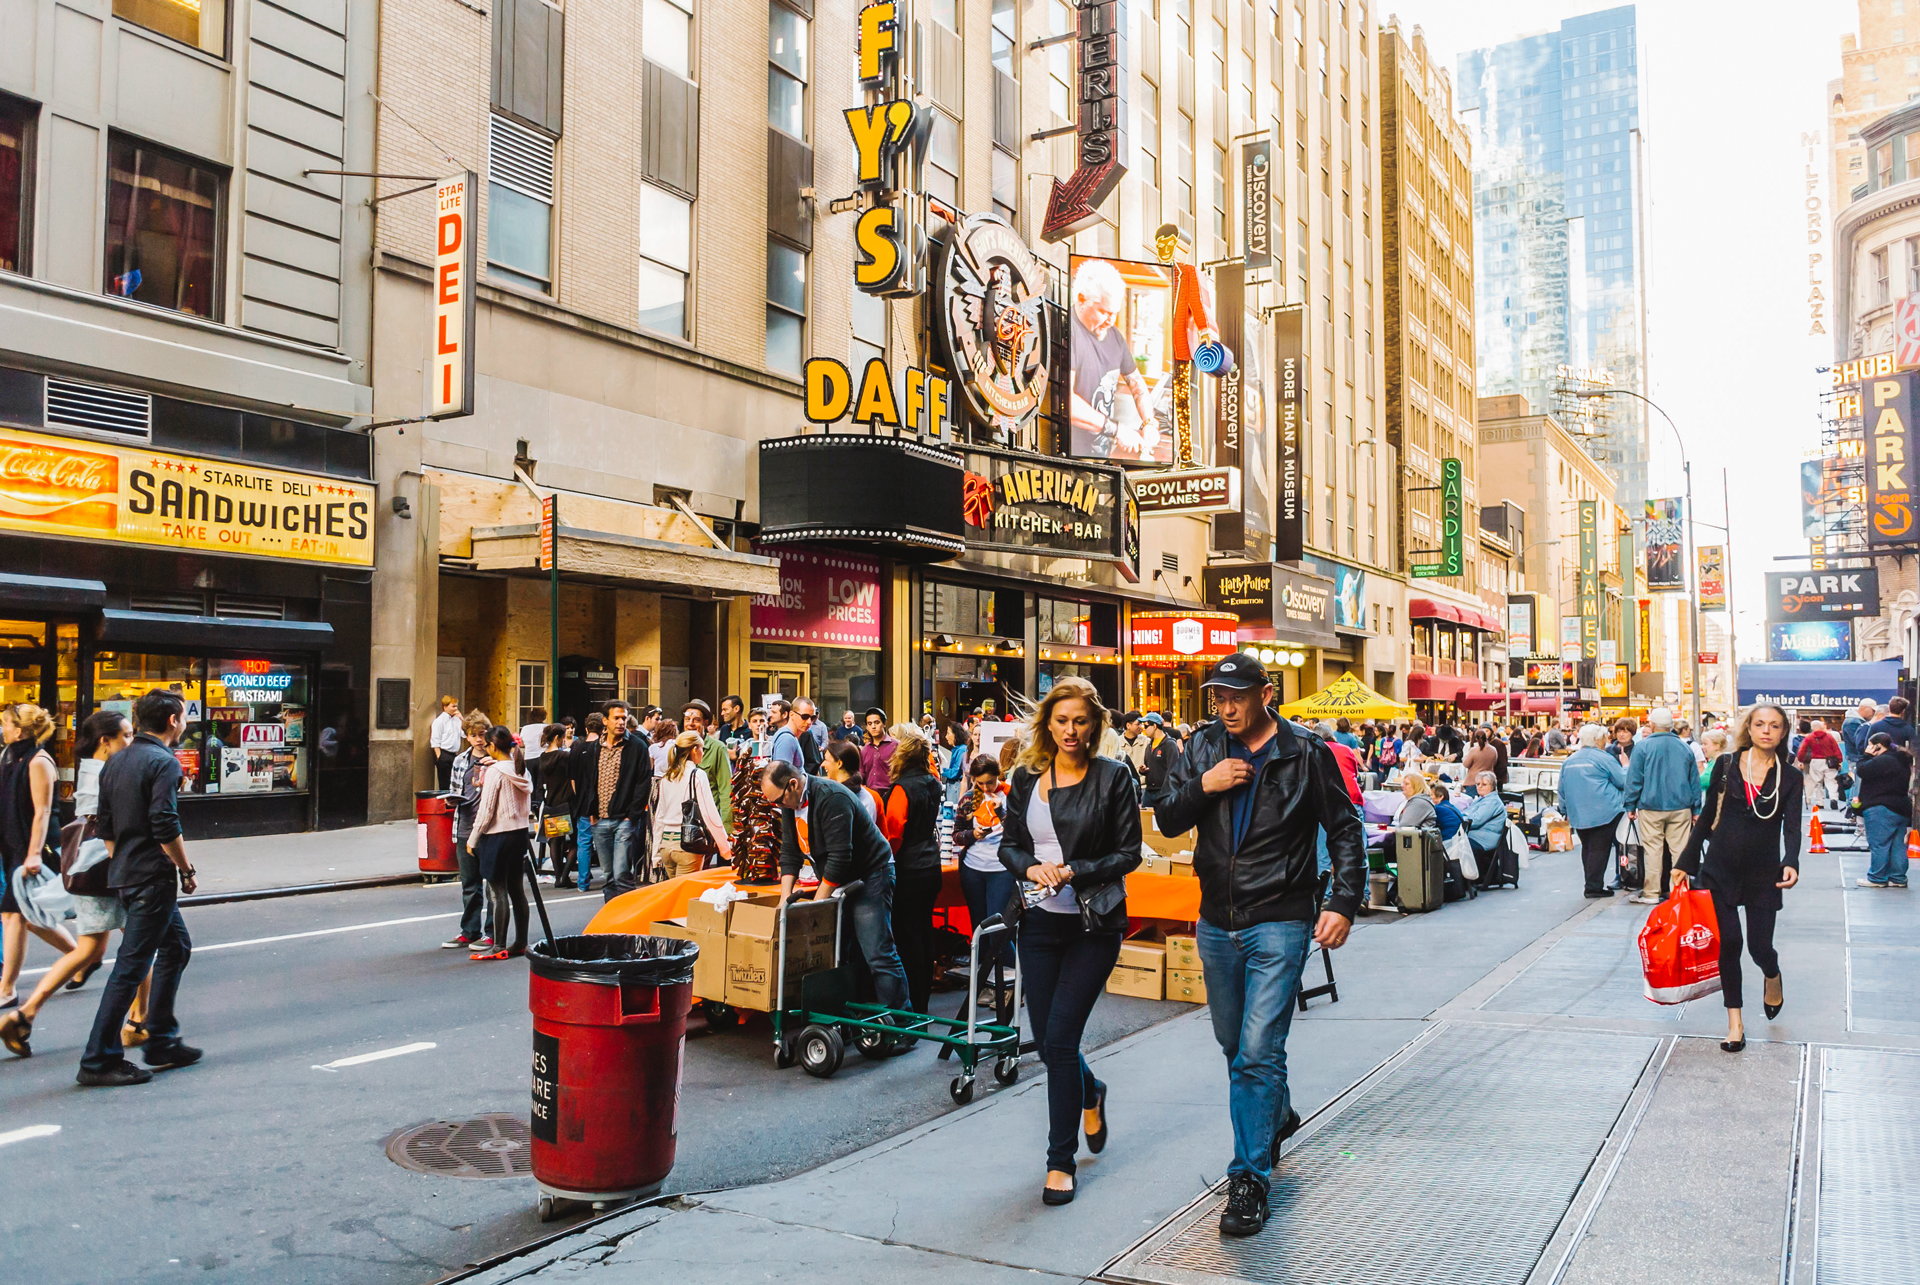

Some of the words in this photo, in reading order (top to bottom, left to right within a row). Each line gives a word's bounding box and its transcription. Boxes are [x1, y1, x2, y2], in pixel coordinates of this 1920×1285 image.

[1083, 0, 1112, 163] IERI'S
[438, 182, 464, 199] STAR
[1800, 130, 1822, 245] MILFORD
[440, 196, 461, 211] LITE
[1249, 160, 1269, 255] Discovery
[1808, 252, 1826, 336] PLAZA
[438, 213, 462, 405] DELI
[1283, 357, 1295, 399] MORE
[1830, 354, 1898, 386] SHUB
[803, 357, 950, 438] DAFF
[1223, 368, 1241, 450] Discovery
[1284, 402, 1295, 442] THAN
[1873, 380, 1907, 491] PARK
[1284, 446, 1295, 456] A
[0, 446, 107, 490] Coca-Cola
[203, 469, 273, 492] STARLITE
[282, 480, 312, 497] DELI
[1001, 469, 1099, 516] AMERICAN
[1136, 476, 1226, 499] BOWLMOR
[1284, 459, 1295, 521] MUSEUM
[129, 469, 368, 540] SANDWICHES
[1161, 493, 1200, 506] LANES
[1875, 493, 1910, 505] icon
[994, 512, 1062, 535] KITCHEN
[1074, 522, 1103, 539] BAR
[162, 522, 206, 541] TAKE
[220, 529, 251, 546] OUT
[290, 537, 339, 555] EAT-IN
[828, 577, 875, 607] LOW
[1218, 576, 1244, 596] Harry
[1243, 574, 1271, 598] Potter
[1780, 574, 1862, 595] PARK
[1800, 595, 1824, 603] icon
[828, 604, 875, 625] PRICES.
[1583, 564, 1598, 659] JAMES
[1132, 629, 1163, 645] NING!
[1780, 634, 1839, 650] Matilda
[245, 660, 269, 673] HOT
[224, 674, 266, 687] CORNED
[267, 675, 292, 687] BEEF
[233, 690, 282, 702] PASTRAMI
[1755, 694, 1806, 706] Shubert
[1811, 694, 1861, 707] Theatre
[187, 702, 199, 716] A
[211, 709, 249, 721] ATM
[1306, 706, 1365, 716] lionking.com
[246, 726, 280, 743] ATM
[730, 964, 766, 983] Twizzlers
